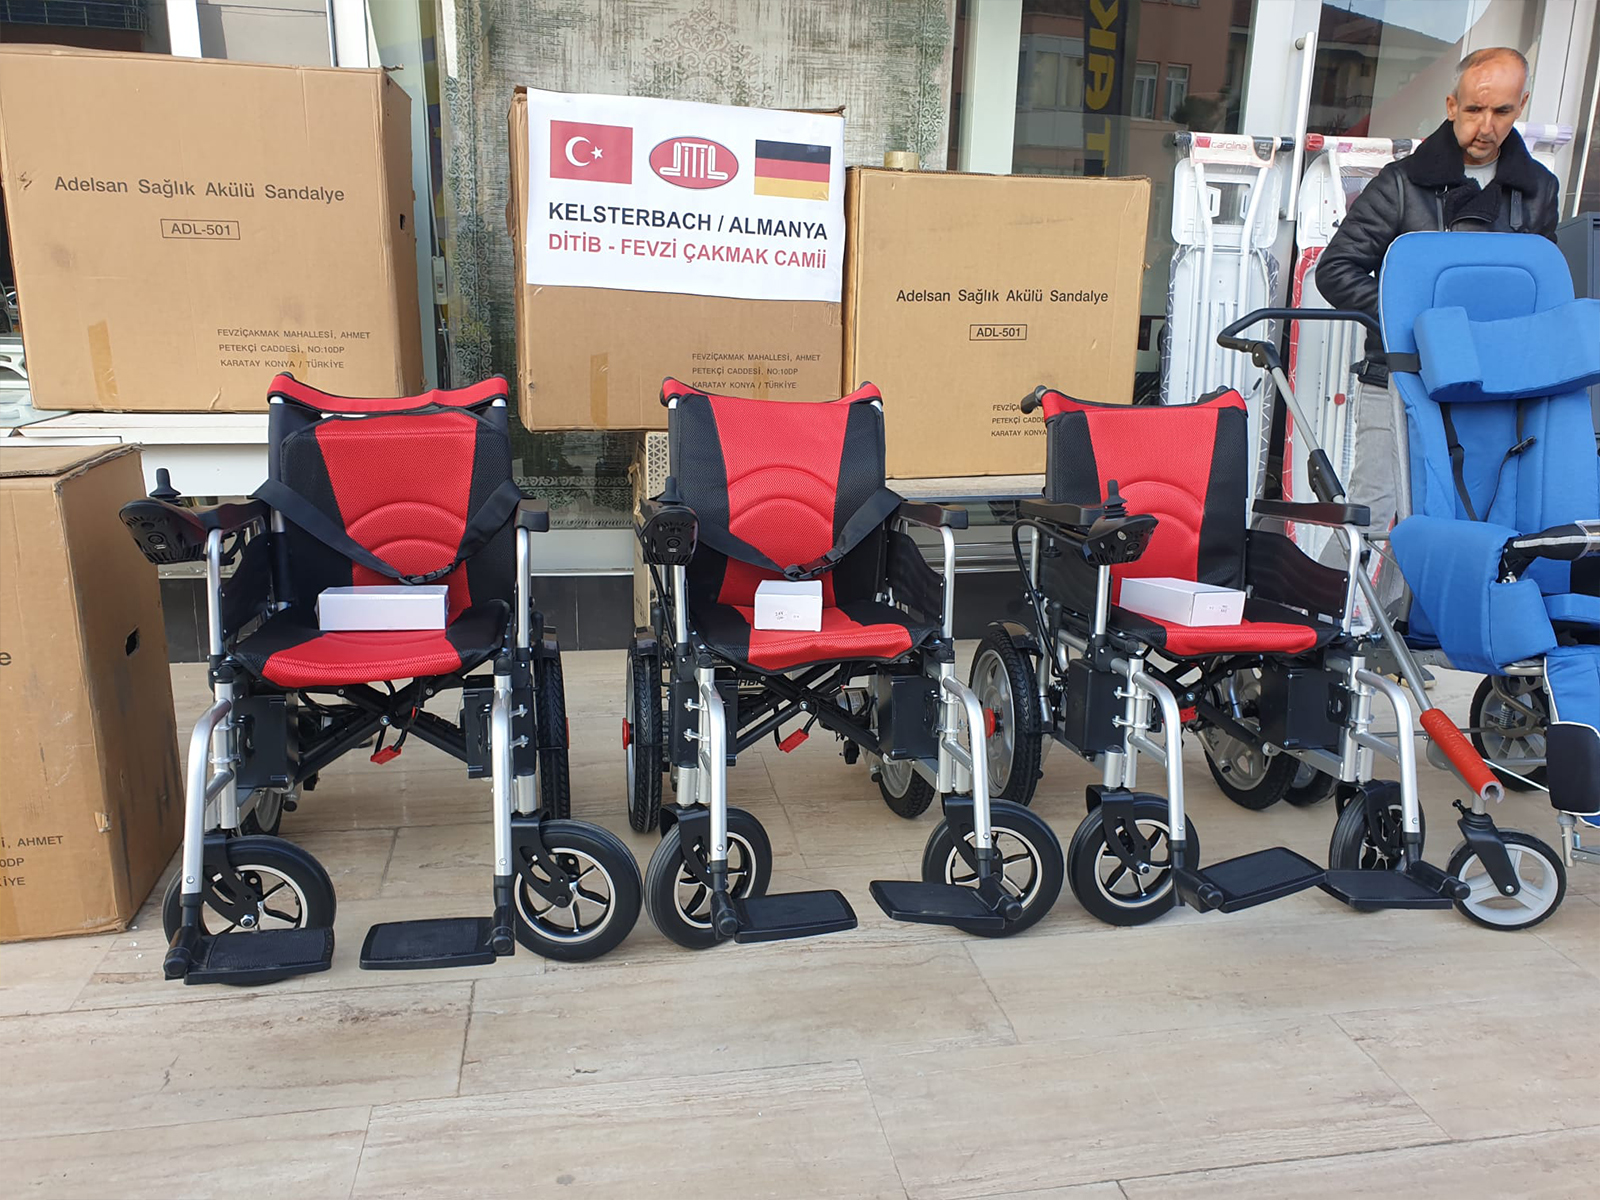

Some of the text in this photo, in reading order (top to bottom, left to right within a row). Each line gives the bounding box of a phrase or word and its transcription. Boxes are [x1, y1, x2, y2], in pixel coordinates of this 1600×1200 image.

[55, 177, 344, 204] Adelsan Sağlık Akülü Sandalye
[550, 202, 711, 233] KELSTERBACH
[729, 217, 827, 240] ALMANYA
[171, 223, 231, 235] ADL-501
[549, 230, 601, 253] DİTİB
[622, 239, 676, 258] FEVZİ
[684, 244, 768, 264] ÇAKMAK
[775, 249, 826, 268] CAMİİ
[897, 289, 1108, 305] Adelsan Sağlık Akülü Sandalye
[217, 328, 280, 338] FEVZİÇAKMAK
[282, 329, 336, 340] MAHALLESİ,
[976, 327, 1021, 337] ADL-501
[219, 344, 256, 353] PETEKÇİ
[261, 345, 303, 354] CADDESİ,
[692, 352, 744, 361] FEVZİÇAKMAK
[747, 353, 793, 362] MAHALLESİ,
[220, 359, 260, 367] KARATAY
[307, 359, 344, 368] TÜRKİYE
[765, 380, 796, 388] TÜRKİYE
[18, 836, 63, 846] AHMET
